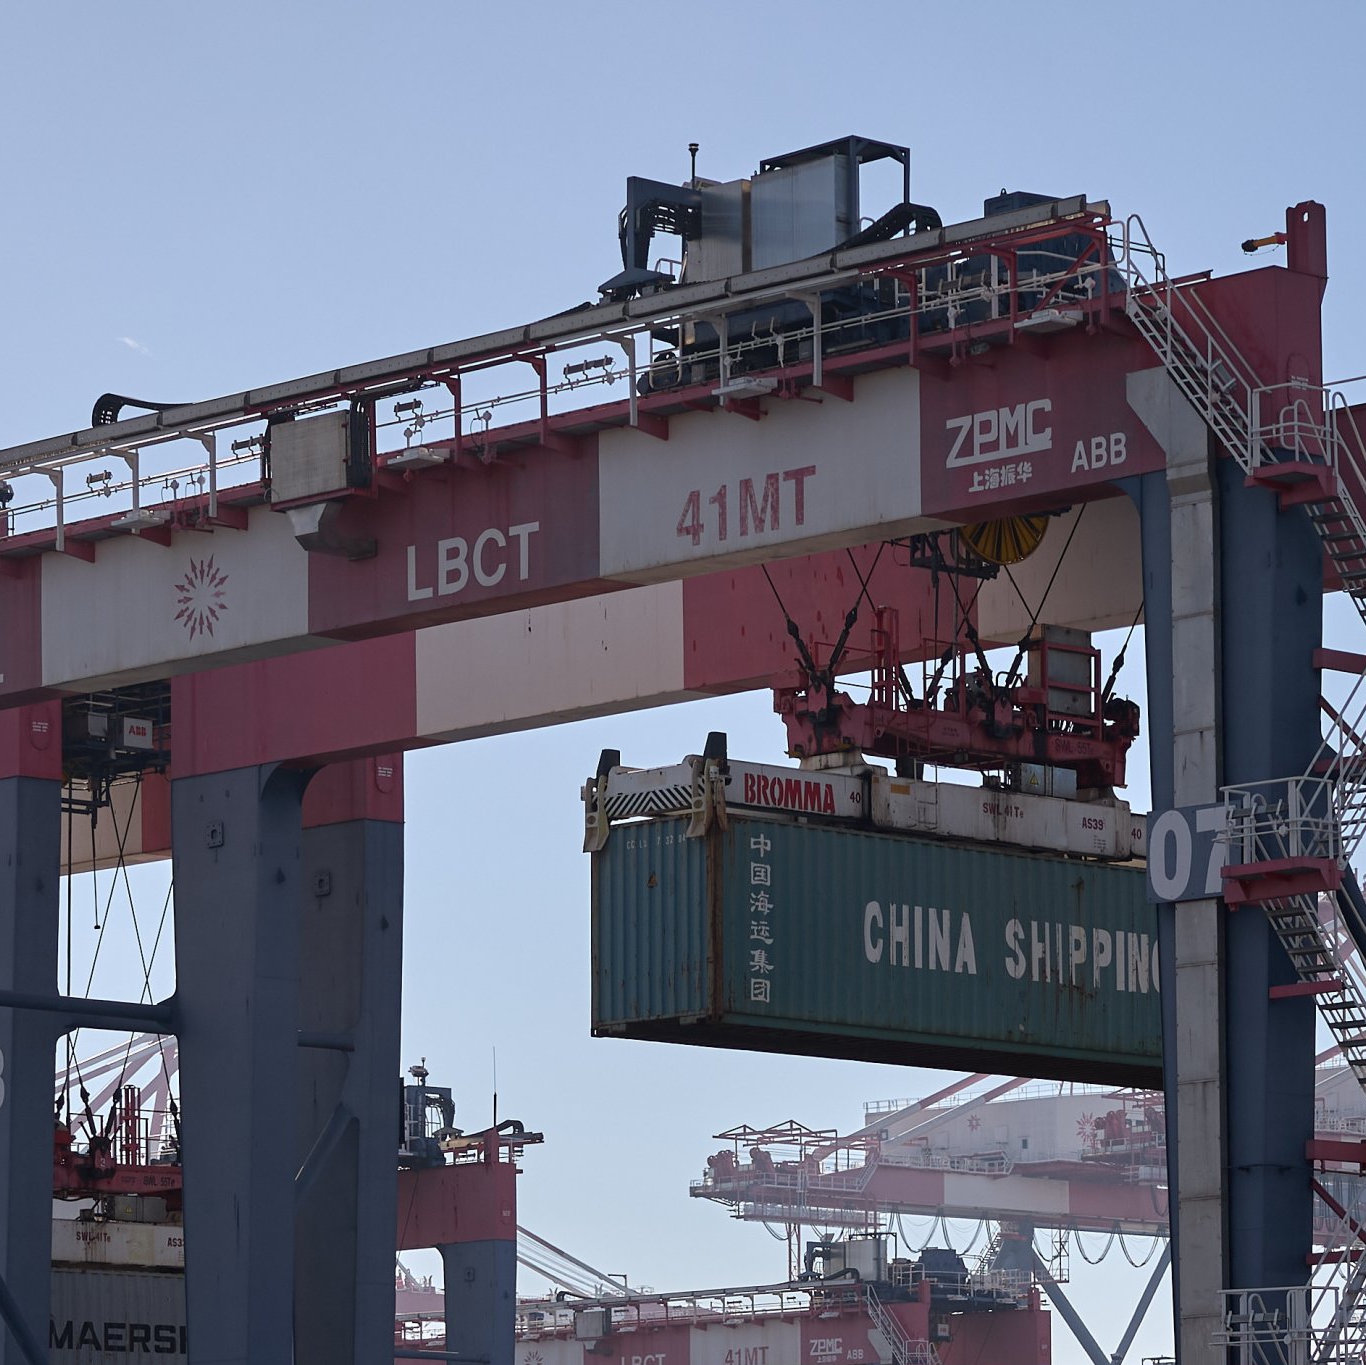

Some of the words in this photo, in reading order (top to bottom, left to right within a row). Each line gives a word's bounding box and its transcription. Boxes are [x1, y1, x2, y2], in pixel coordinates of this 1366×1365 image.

[946, 399, 1052, 469] ZPMC
[1071, 432, 1127, 473] ABB
[968, 461, 1033, 493] 上海振华
[677, 466, 816, 547] 41MT
[407, 522, 540, 601] LBCT
[129, 726, 146, 737] ABB
[744, 772, 835, 815] BROMMA
[850, 792, 861, 804] 40
[1082, 817, 1104, 831] AS39
[1150, 805, 1235, 900] 07
[749, 834, 774, 1003] 中国海运集团
[864, 901, 977, 975] CHINA
[167, 1237, 184, 1248] AS3
[810, 1338, 843, 1356] ZPMC
[847, 1350, 864, 1361] ABB
